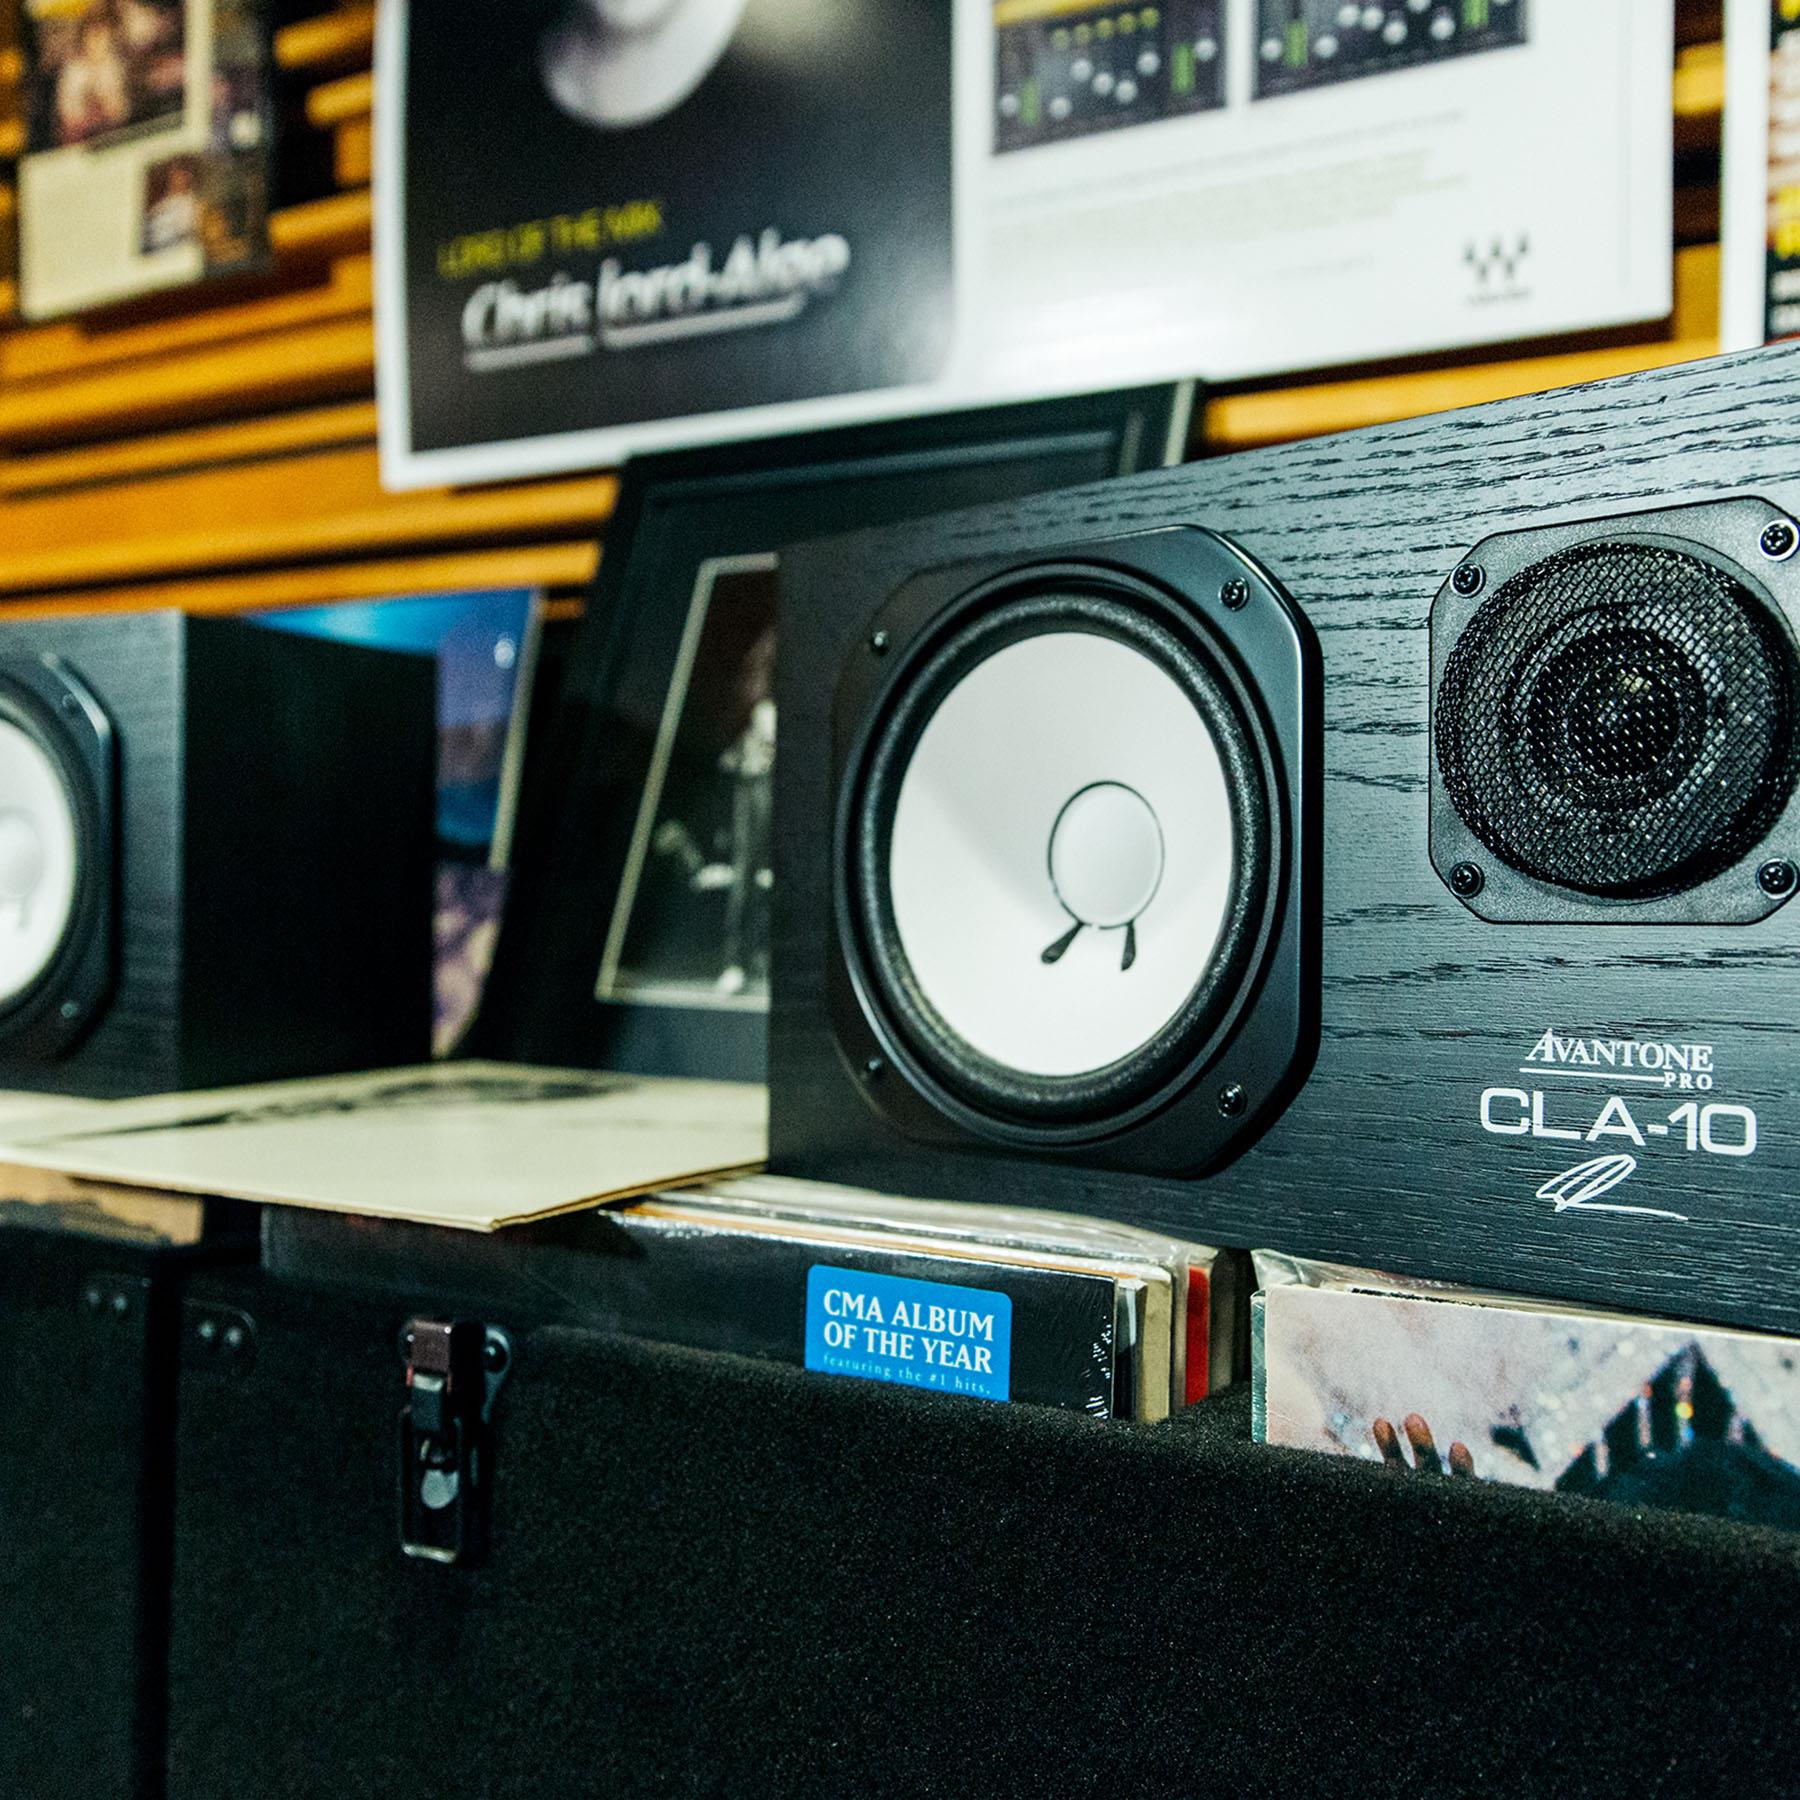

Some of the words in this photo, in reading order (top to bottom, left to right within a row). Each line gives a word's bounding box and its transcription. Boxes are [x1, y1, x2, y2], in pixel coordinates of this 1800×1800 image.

[1525, 1028, 1714, 1072] AVANTONE
[1664, 1072, 1713, 1090] PRO
[1480, 1087, 1757, 1156] CLA-10
[823, 1289, 884, 1324] CMA
[891, 1300, 994, 1342] ALBUM
[823, 1321, 857, 1349] OF
[863, 1327, 915, 1360] THE
[921, 1337, 992, 1374] YEAR
[823, 1352, 891, 1378] featuring
[898, 1367, 921, 1382] the
[929, 1374, 946, 1386] #1
